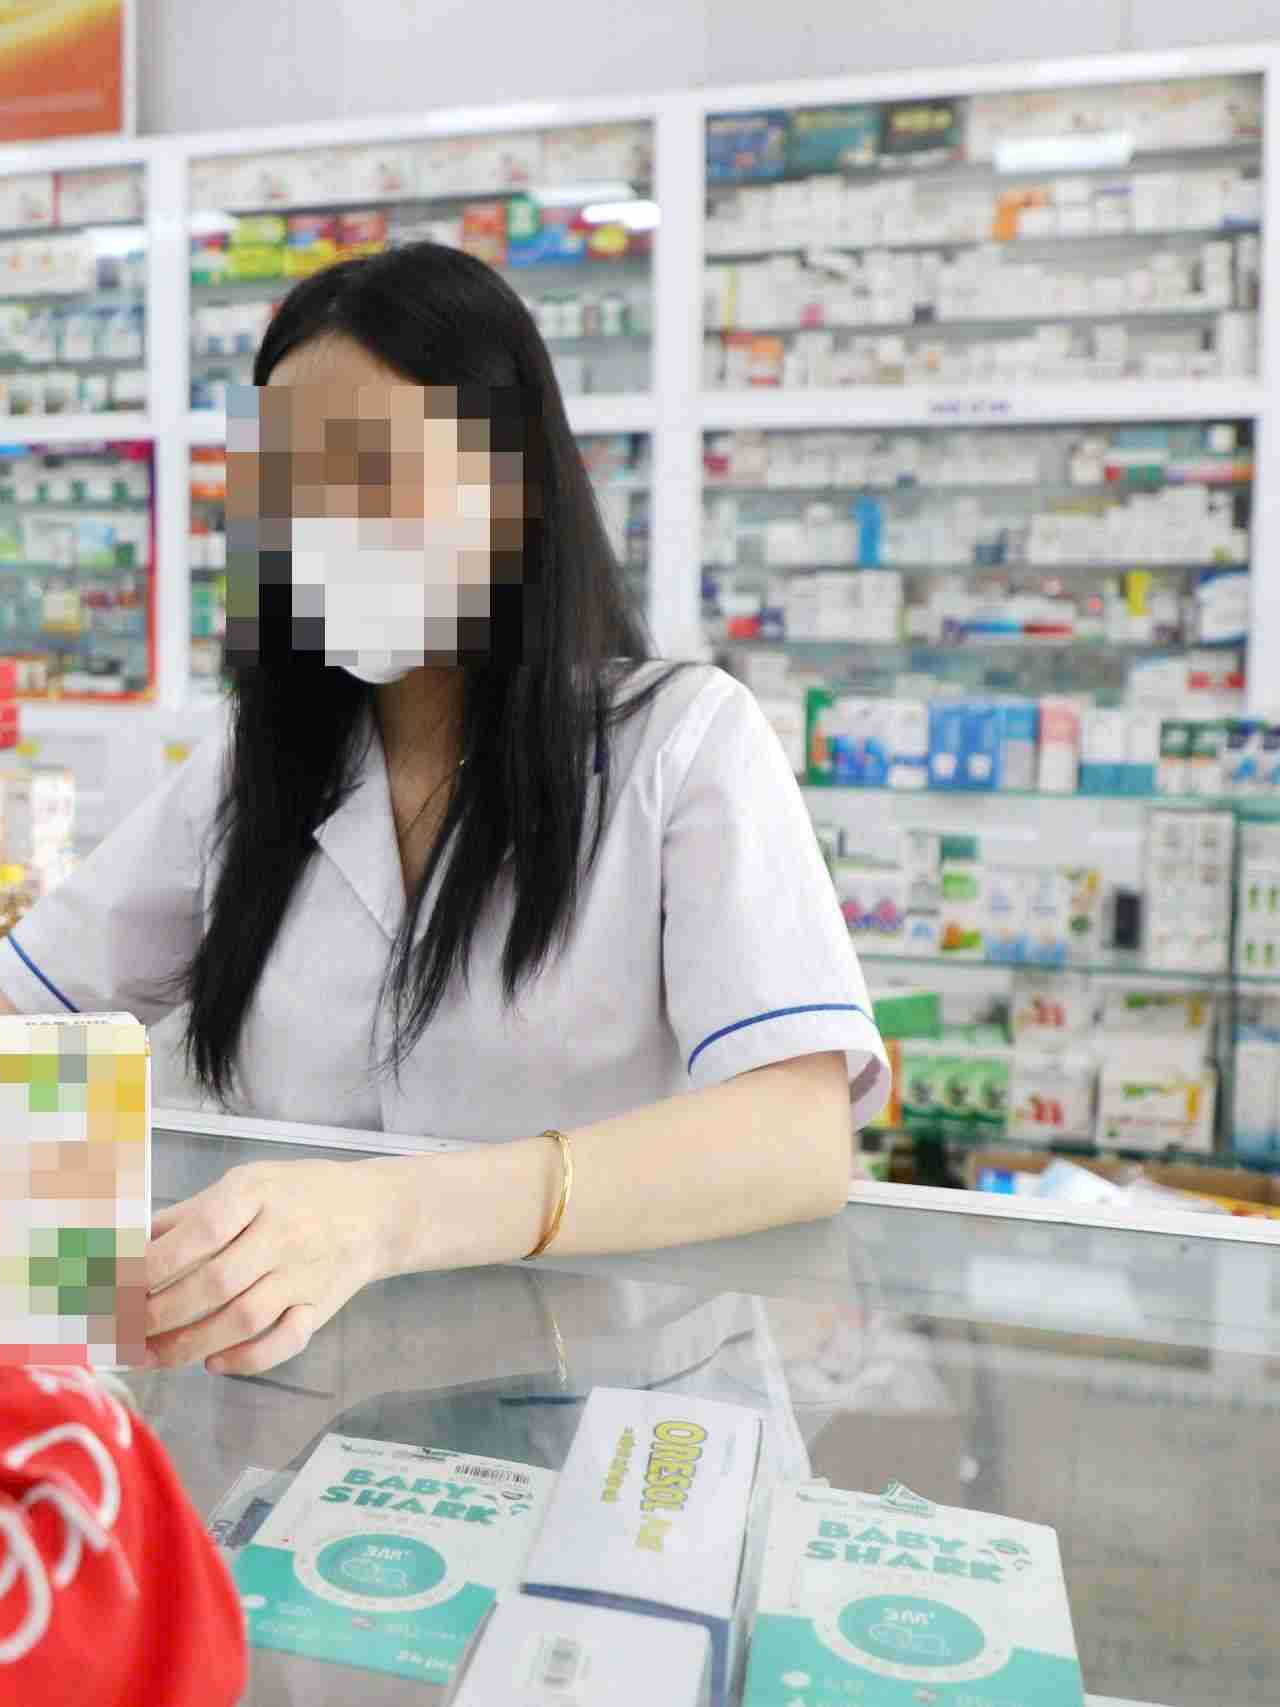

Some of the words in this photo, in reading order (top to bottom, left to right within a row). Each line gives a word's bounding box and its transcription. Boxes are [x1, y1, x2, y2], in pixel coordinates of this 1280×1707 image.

[342, 1468, 477, 1499] BABY
[639, 1420, 708, 1512] ORESOL
[320, 1485, 500, 1526] SHARK
[817, 1519, 967, 1555] BABY
[804, 1540, 1005, 1584] SHARK
